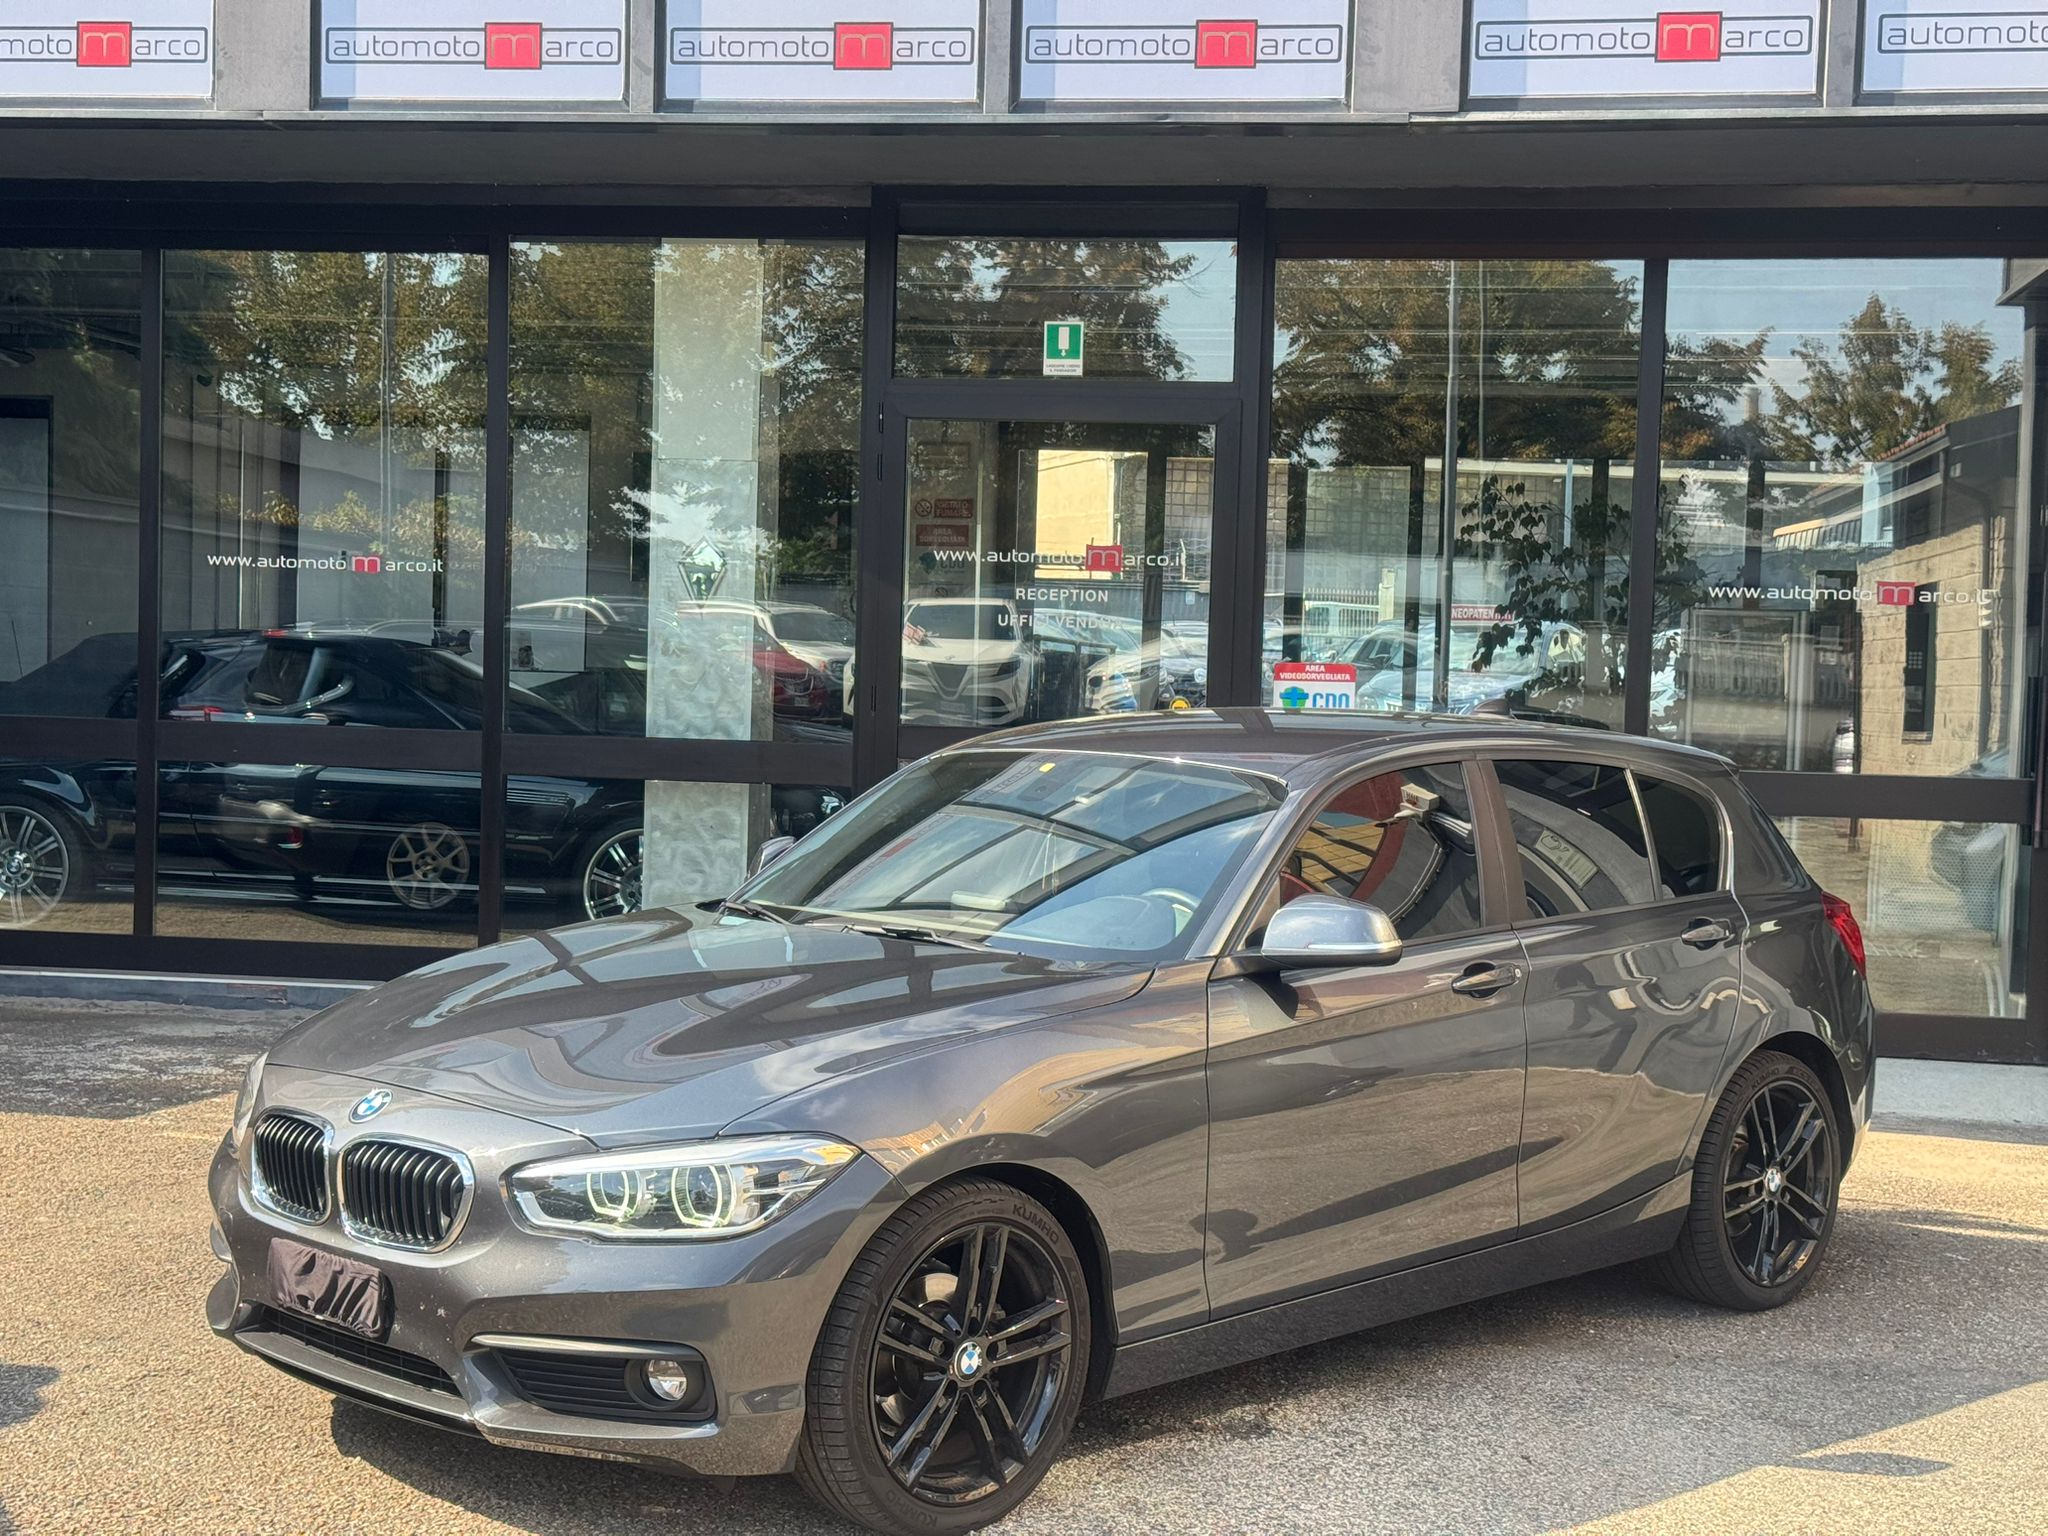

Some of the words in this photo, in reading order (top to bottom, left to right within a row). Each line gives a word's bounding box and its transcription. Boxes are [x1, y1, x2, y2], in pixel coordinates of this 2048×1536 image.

[1015, 588, 1109, 603] RECEPTION
[1304, 664, 1326, 672] AREA
[1279, 672, 1351, 681] VIDEOSORVEGLIATA
[1012, 1204, 1060, 1244] KUMHO
